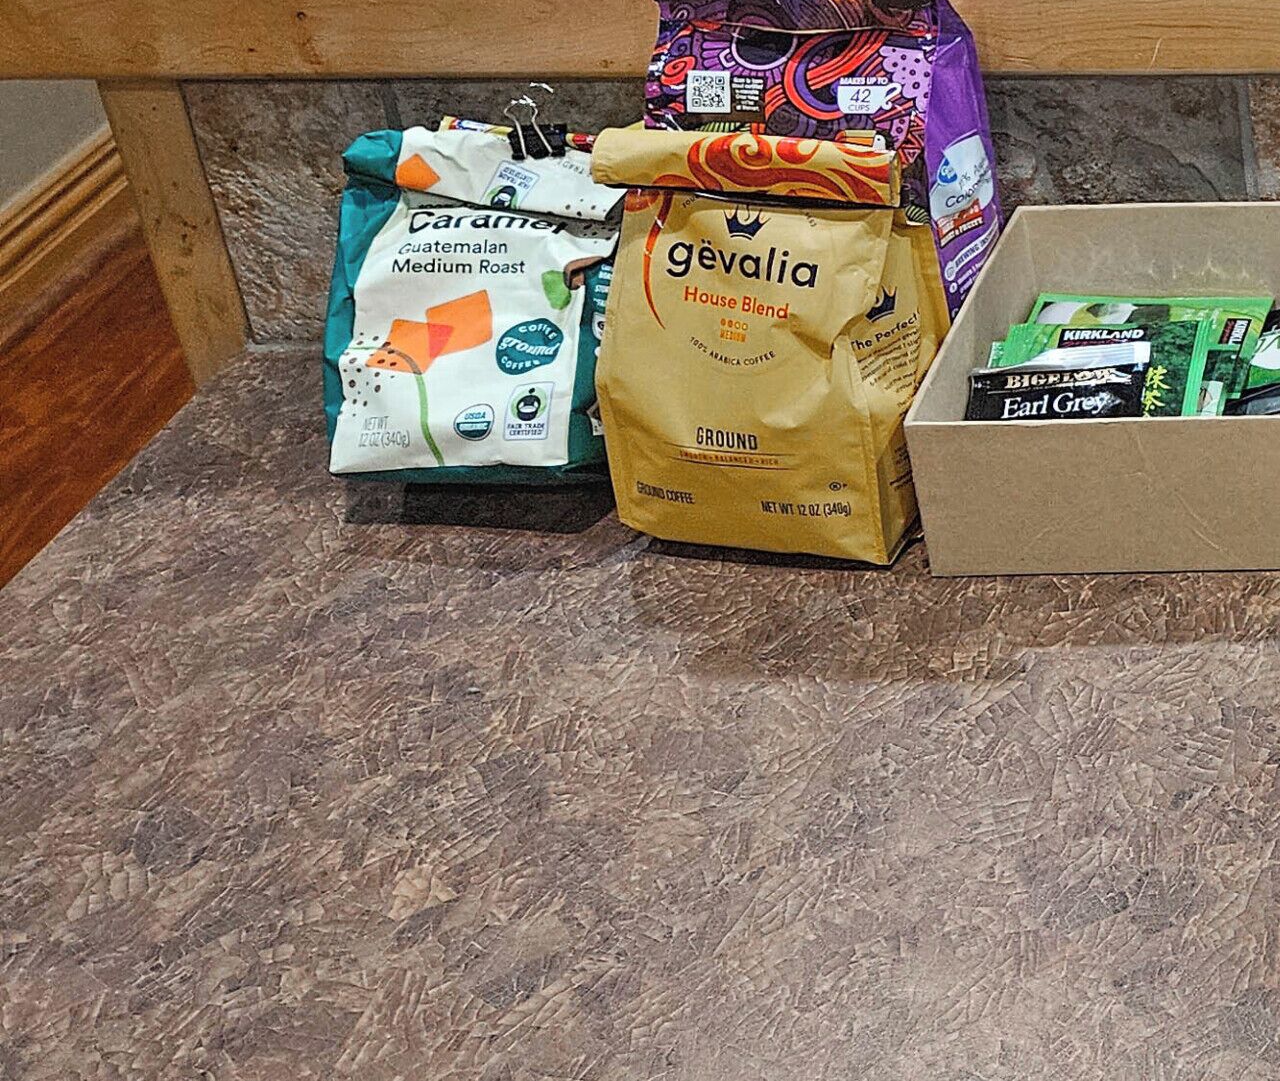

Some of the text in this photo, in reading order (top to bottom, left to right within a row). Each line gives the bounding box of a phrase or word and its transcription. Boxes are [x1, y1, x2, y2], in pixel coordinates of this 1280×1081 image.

[839, 77, 889, 86] MAKES UP TO
[850, 88, 871, 103] 42
[848, 103, 871, 112] CUPS
[398, 239, 508, 255] Guatemalan
[392, 258, 526, 274] Medium Roast
[666, 238, 819, 288] gëvalia
[683, 285, 790, 319] House Blend
[875, 312, 918, 342] Perfect
[1063, 329, 1145, 341] KIRKLAND
[498, 336, 562, 356] ground
[709, 350, 741, 366] ARABICA
[743, 350, 777, 366] COFFEE
[1001, 391, 1110, 419] Earl Grey
[696, 426, 758, 450] GROUND
[636, 480, 696, 504] GROUND COFFEE
[761, 500, 852, 517] NET WT 12 OZ (340g)
